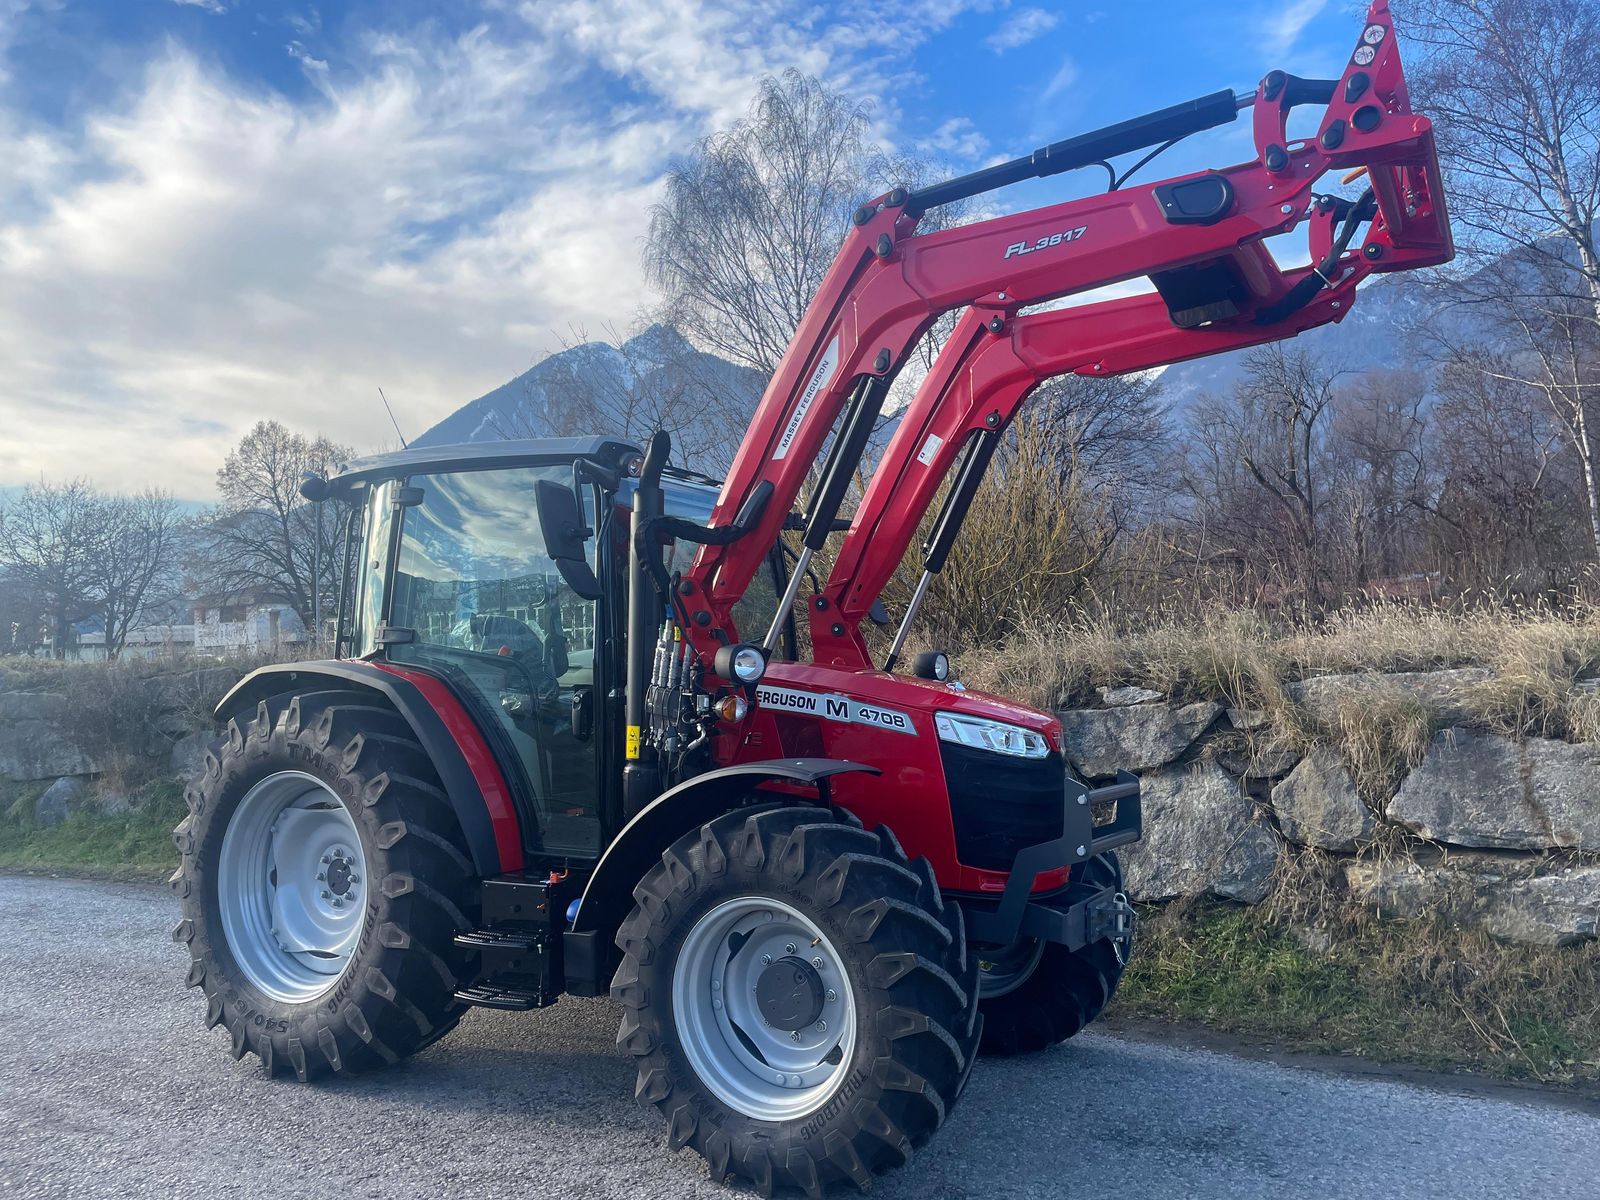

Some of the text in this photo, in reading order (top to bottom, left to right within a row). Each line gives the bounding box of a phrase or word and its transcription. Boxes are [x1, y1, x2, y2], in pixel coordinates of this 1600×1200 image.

[1003, 225, 1088, 259] FL.3817
[782, 360, 829, 448] MASSEY FERGUSON
[756, 690, 906, 728] ERGUSON M 4708
[800, 1068, 869, 1141] TRELLEBORG
